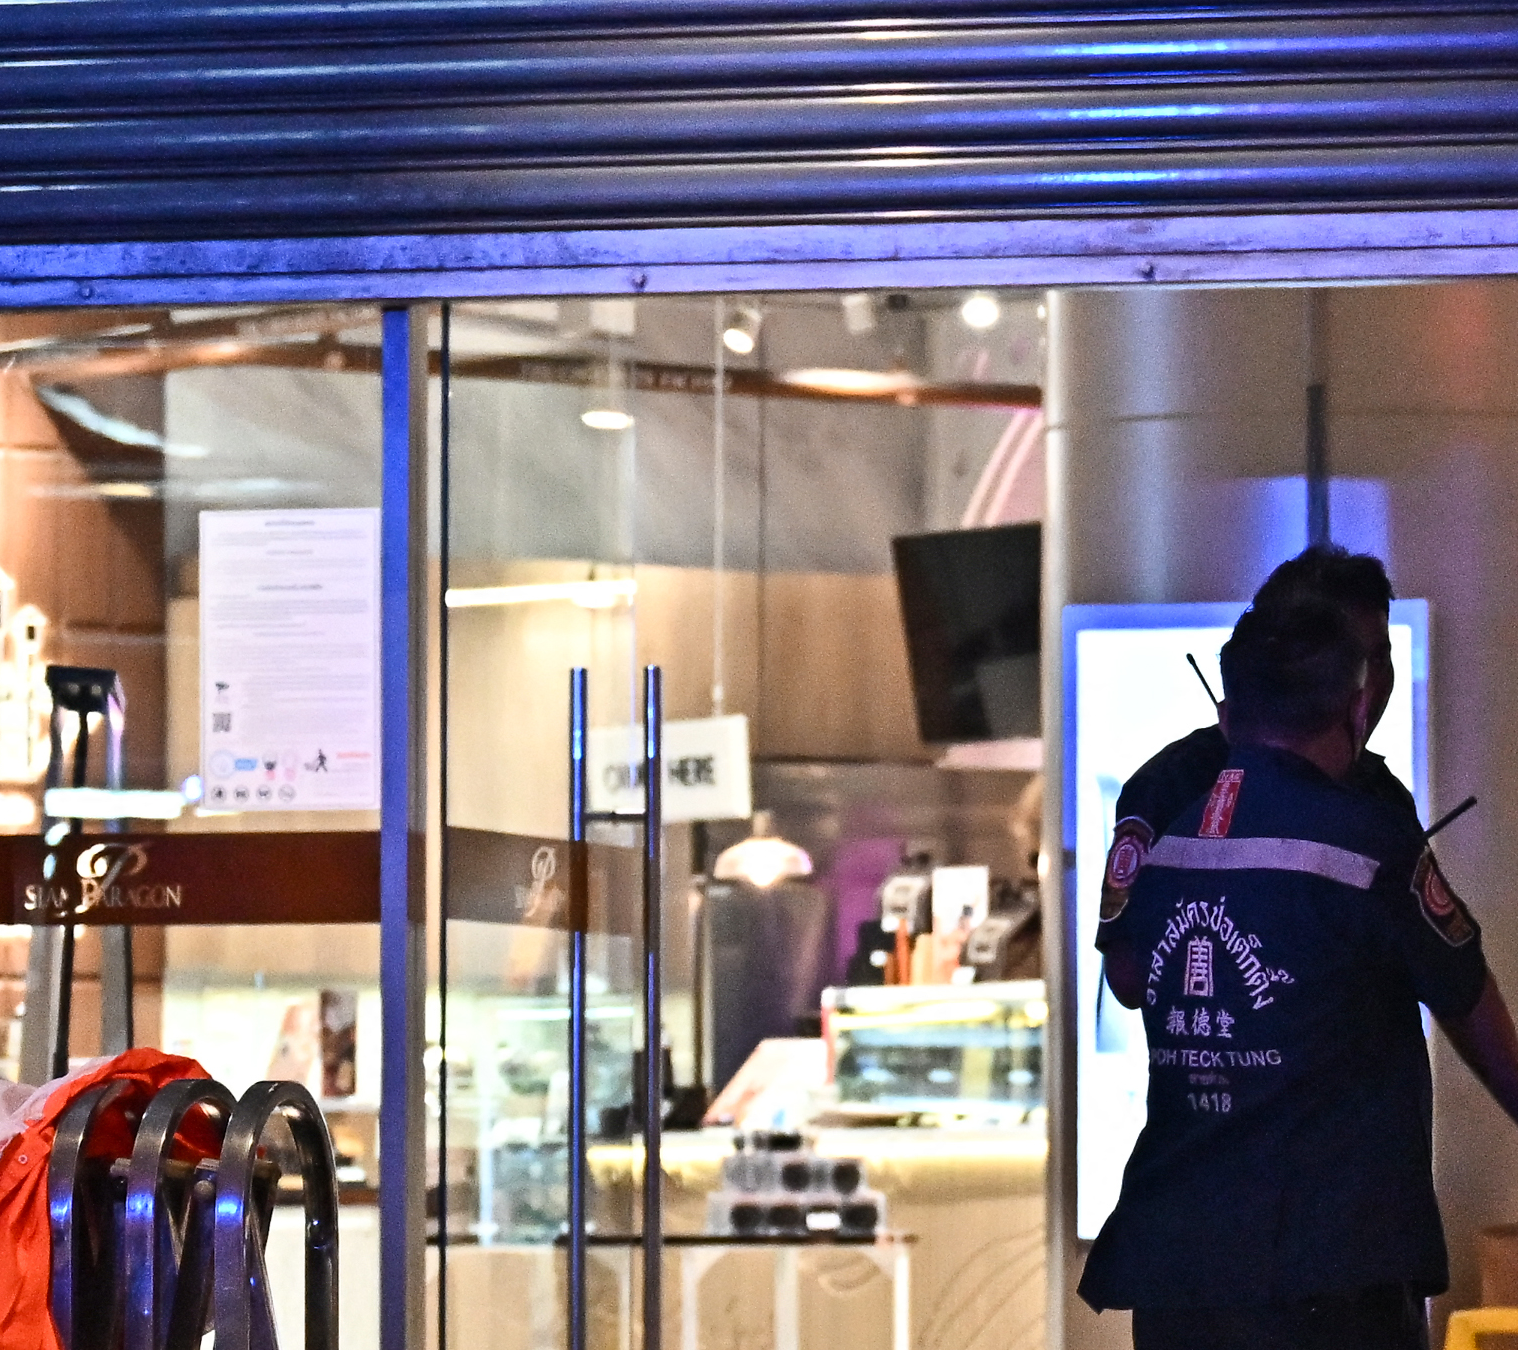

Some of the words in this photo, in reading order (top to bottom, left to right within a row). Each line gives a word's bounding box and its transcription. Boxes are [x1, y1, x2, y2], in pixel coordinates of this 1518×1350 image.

[1165, 1006, 1236, 1039] 報德堂
[1181, 1051, 1225, 1067] TECK
[1223, 1049, 1283, 1067] TUNG
